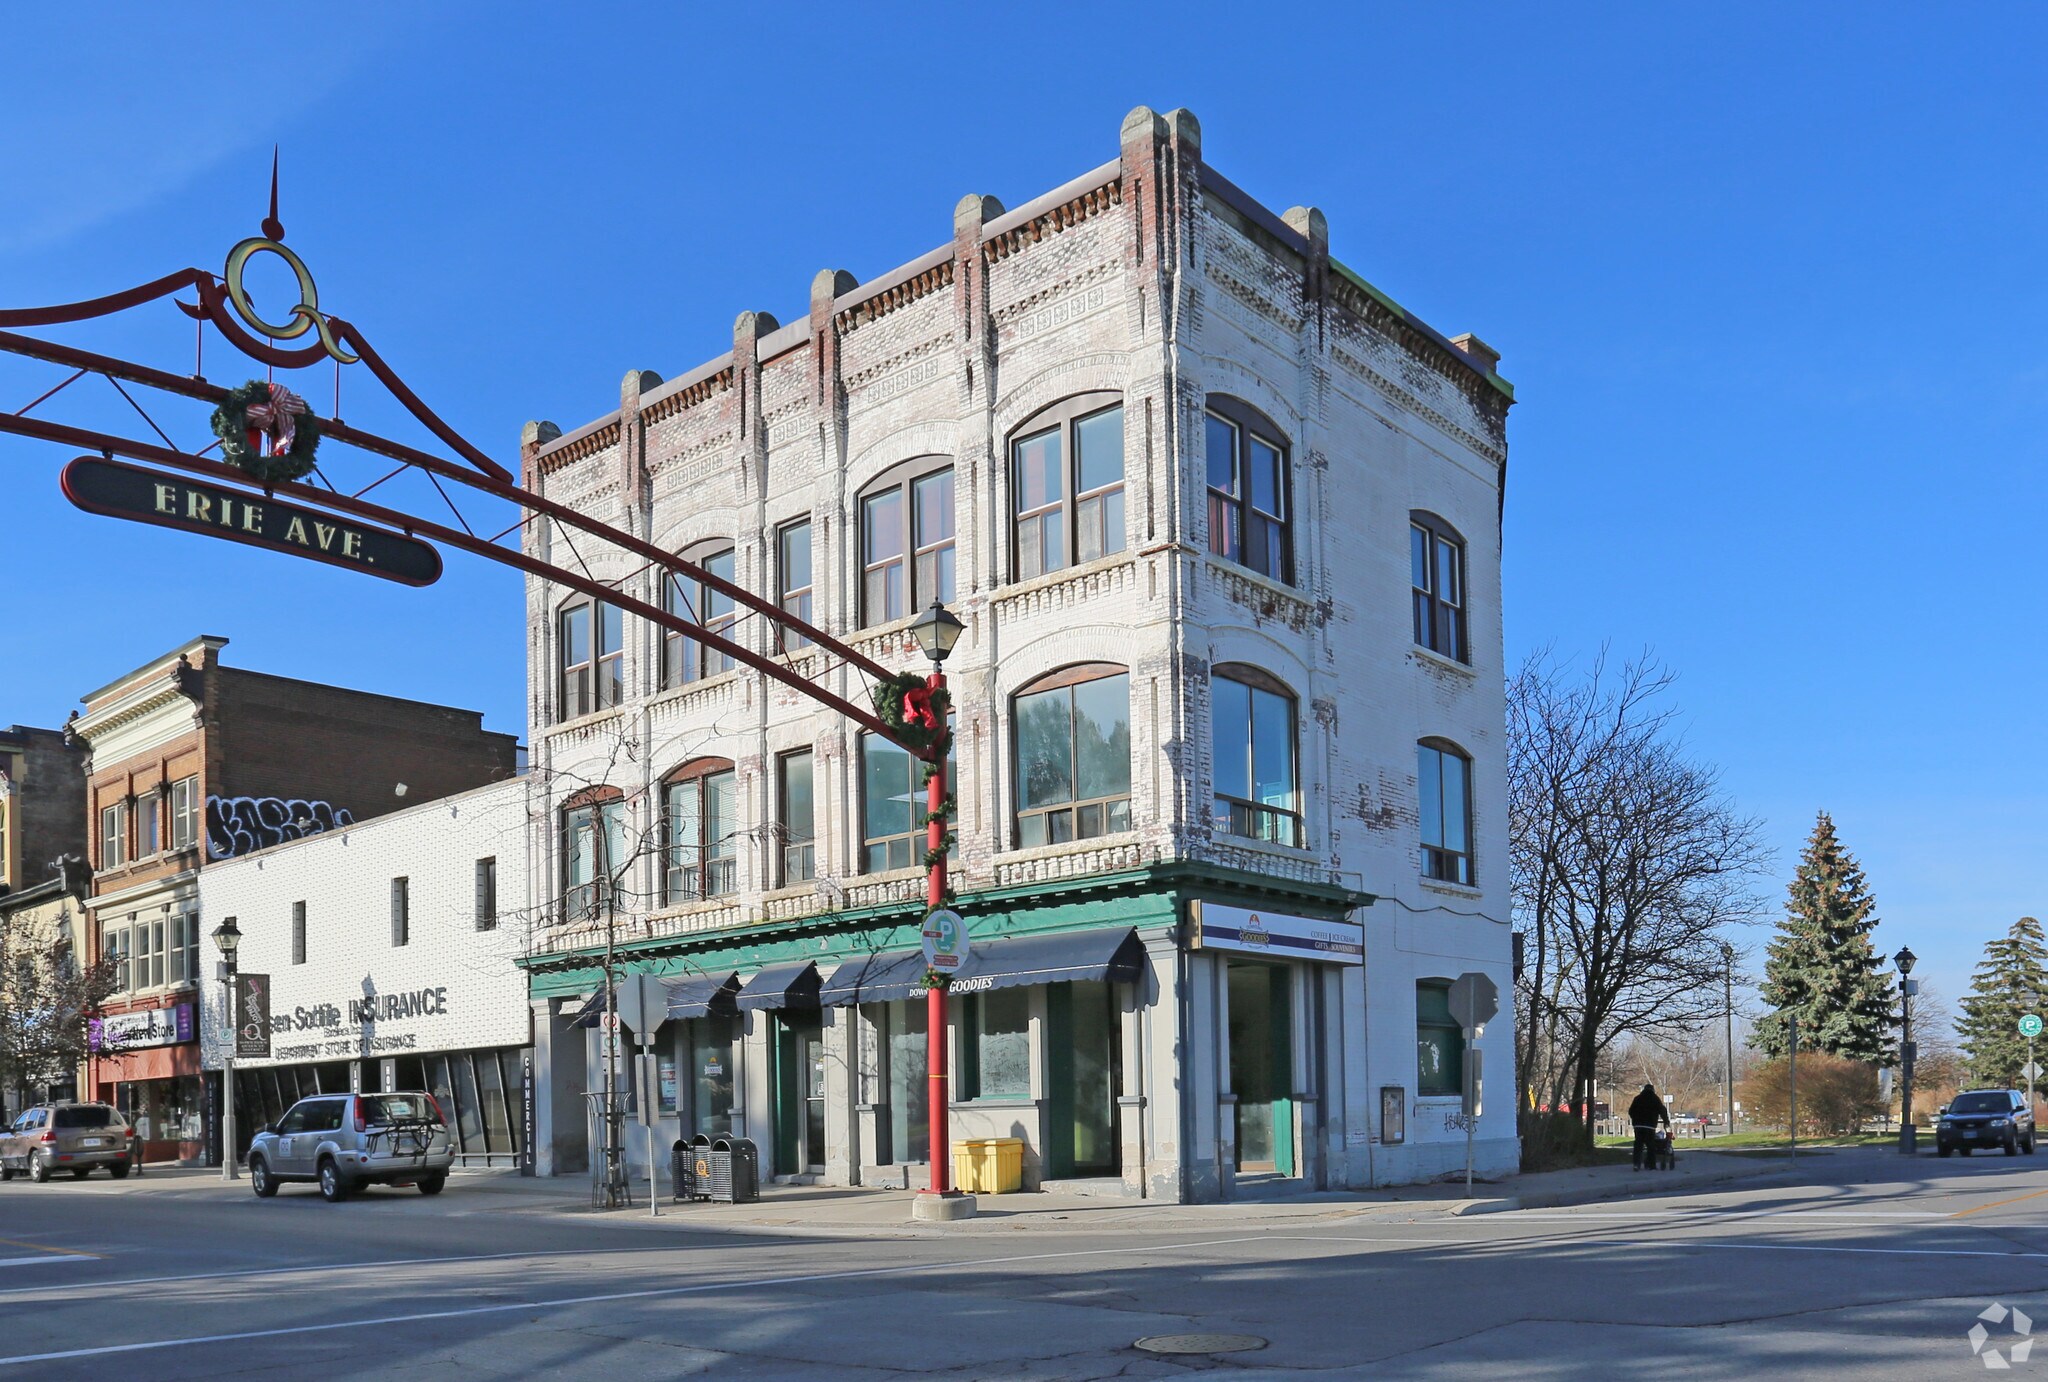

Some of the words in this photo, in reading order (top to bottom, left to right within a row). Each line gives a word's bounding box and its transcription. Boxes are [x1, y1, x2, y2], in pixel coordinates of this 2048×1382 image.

[154, 483, 263, 534] ERIE
[284, 515, 375, 563] AVE.
[1310, 930, 1328, 940] COFFEE
[1340, 935, 1356, 943] CREAM
[1314, 941, 1328, 949] GIFTS
[949, 977, 994, 993] GOODIES
[348, 986, 447, 1024] INSURANCE
[152, 1023, 175, 1039] Store
[324, 1040, 351, 1055] STORE
[353, 1038, 365, 1052] OF
